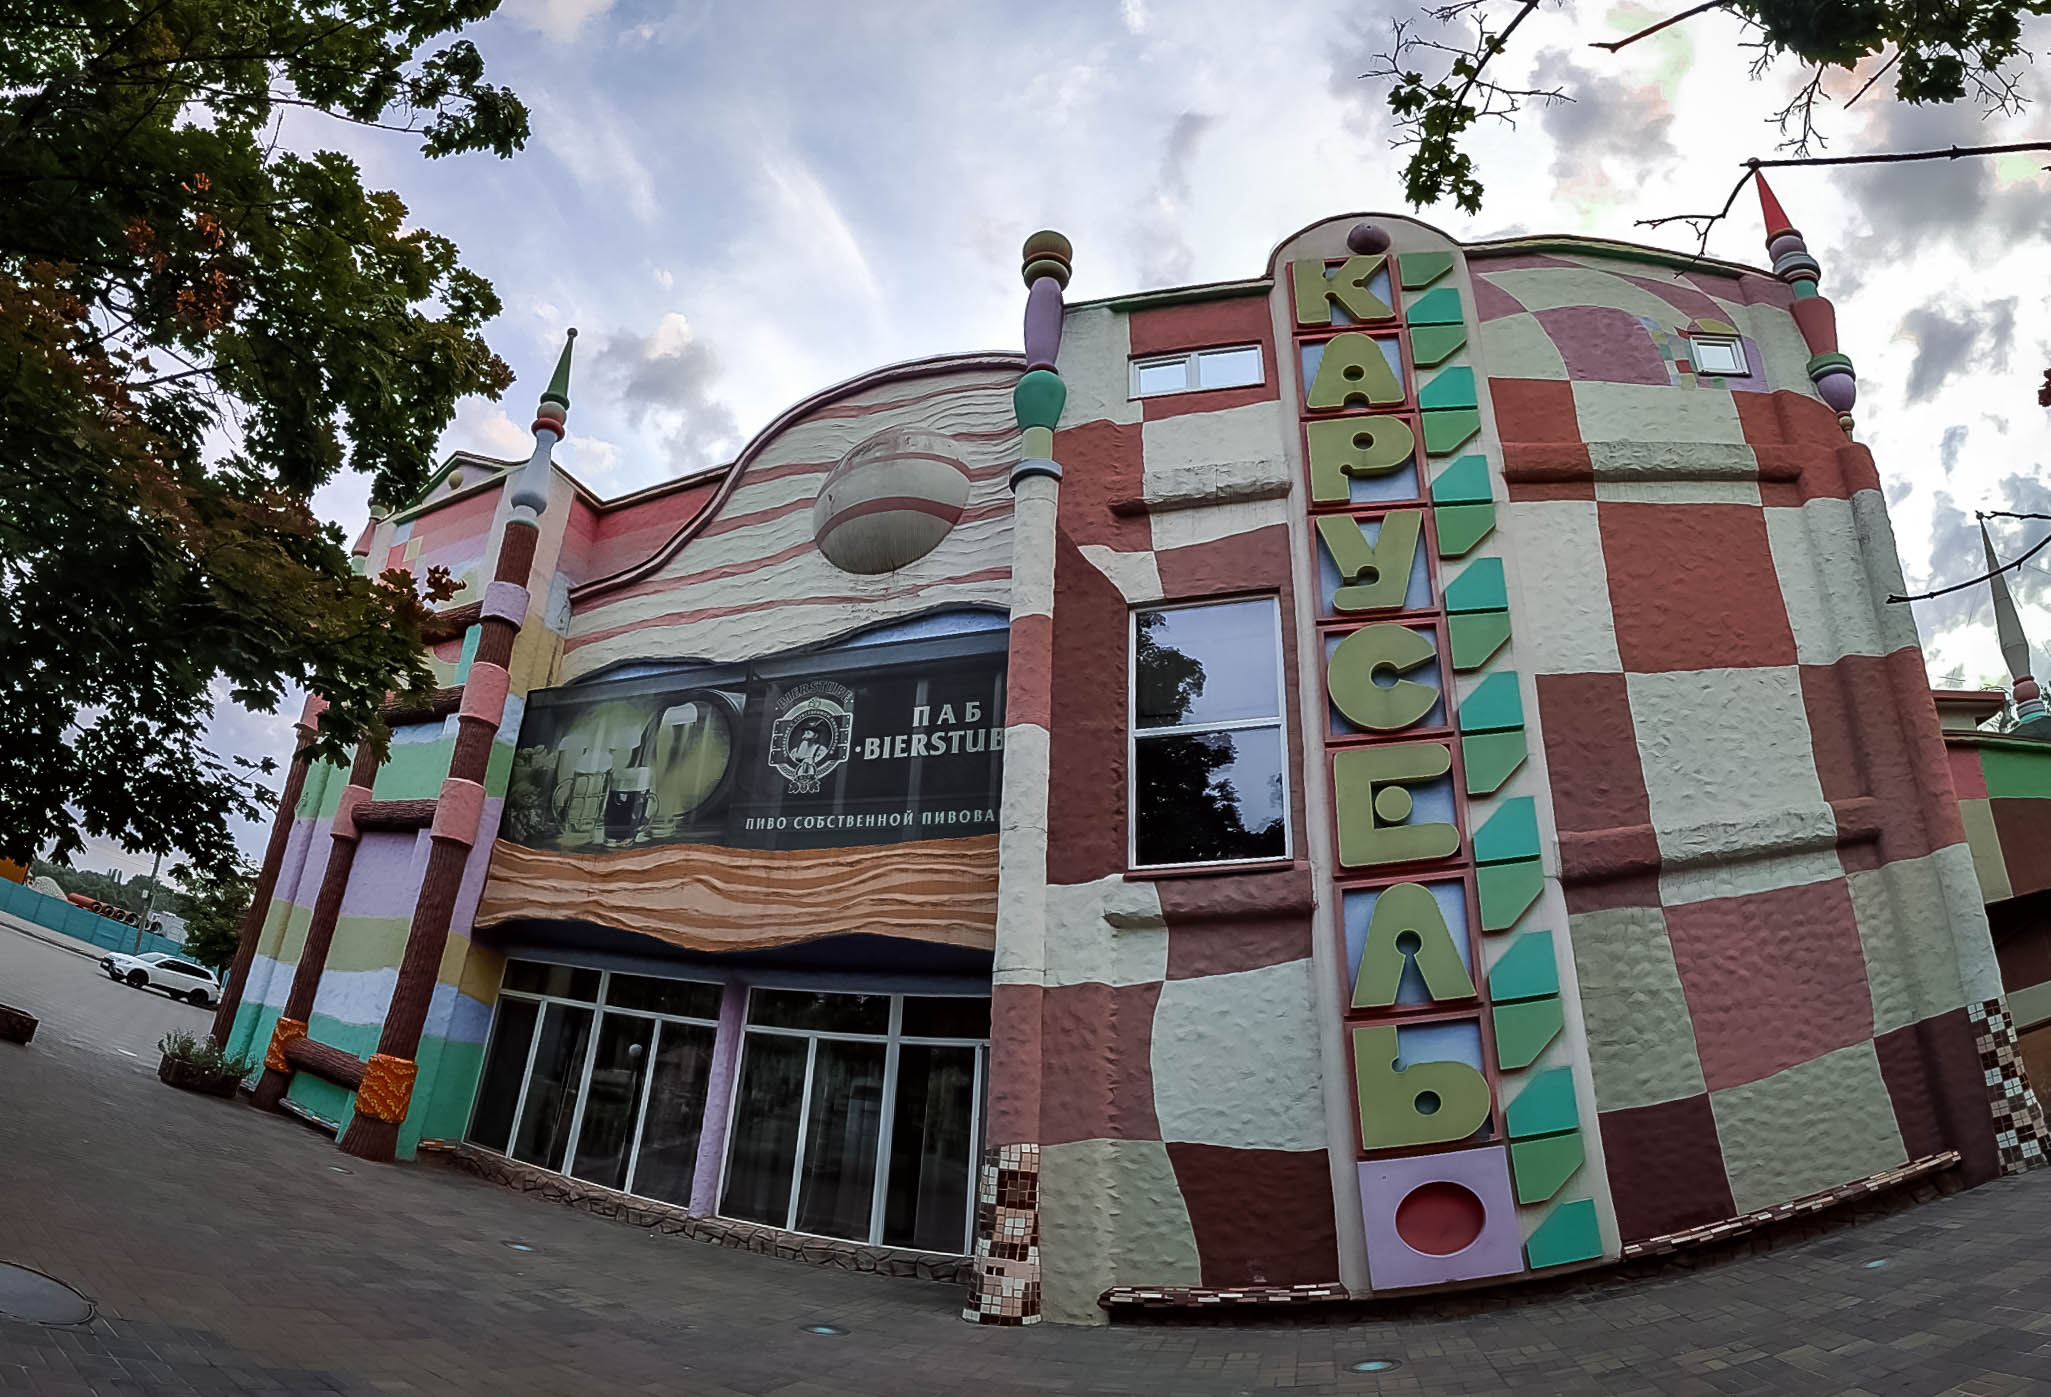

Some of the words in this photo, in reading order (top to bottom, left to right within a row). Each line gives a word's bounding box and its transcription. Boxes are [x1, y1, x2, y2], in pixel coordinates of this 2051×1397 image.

[912, 701, 982, 727] ПАБ
[1292, 254, 1490, 1150] КАРУСЕЛЬ
[745, 817, 787, 830] ПИВО
[793, 809, 914, 829] СОБСТВЕННОЙ
[921, 808, 995, 825] ПИВОВА
